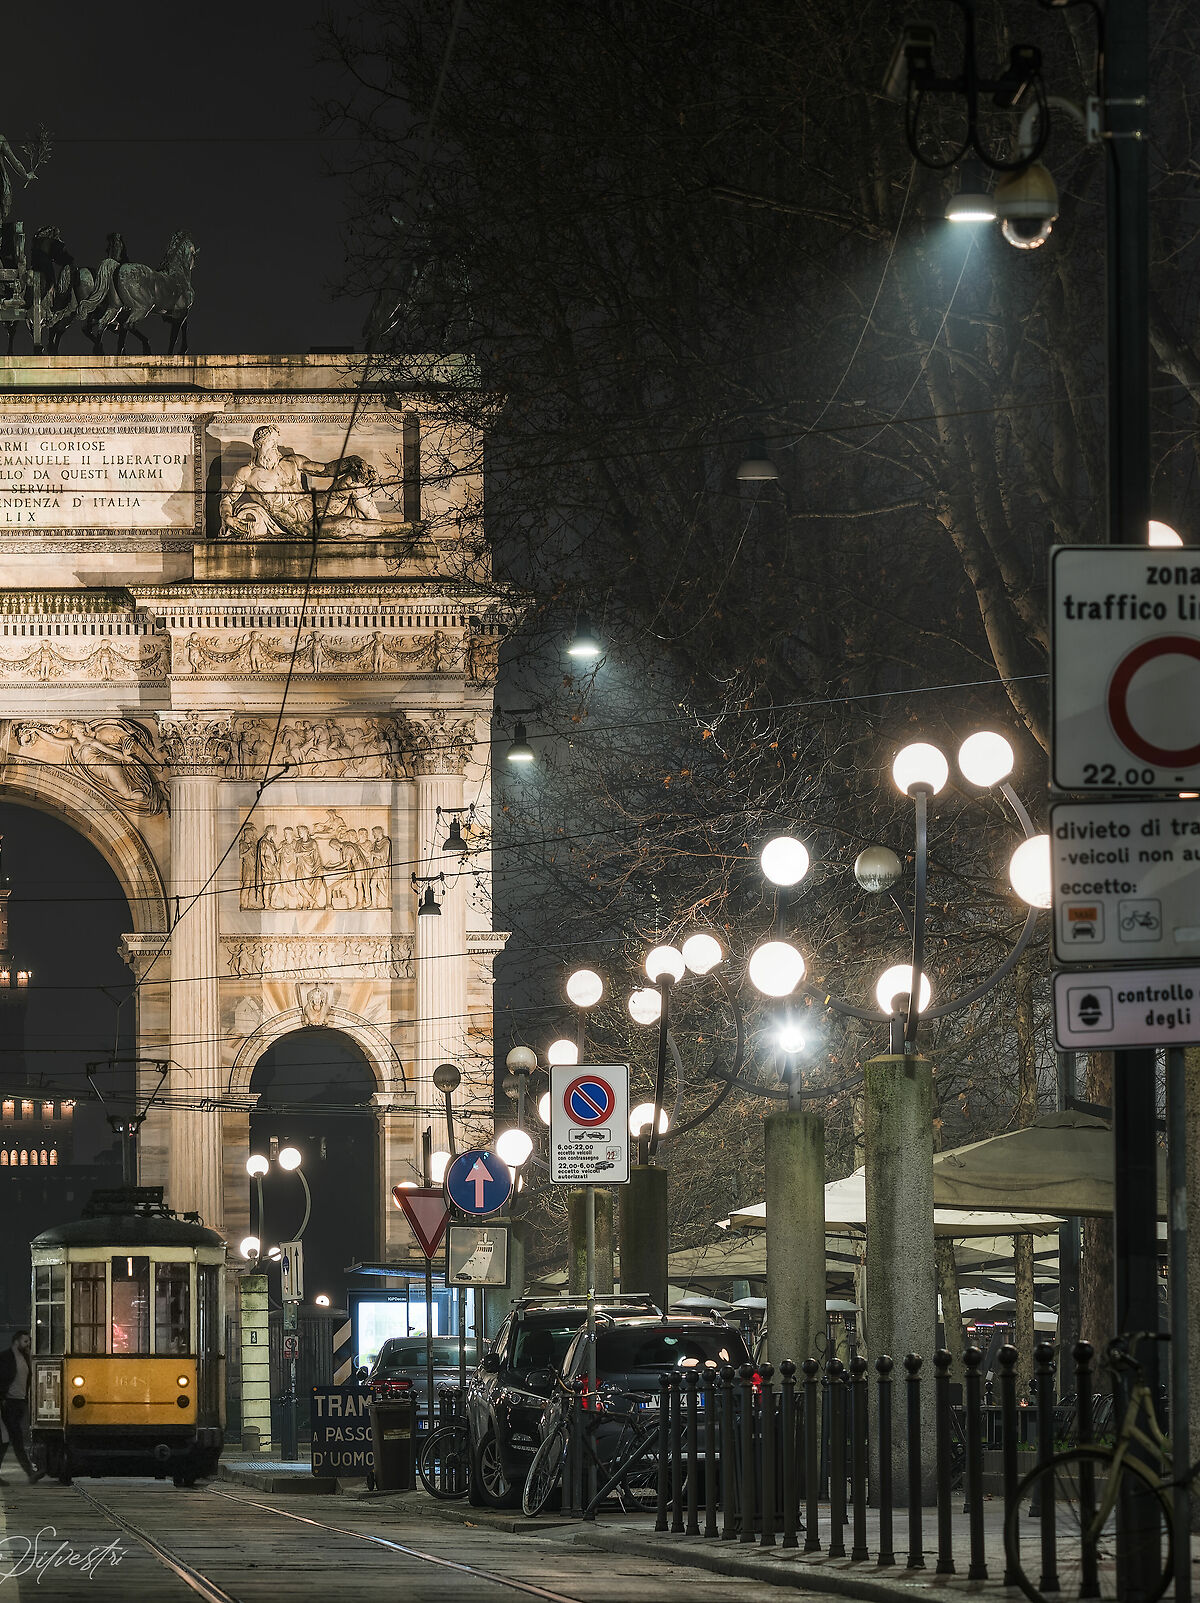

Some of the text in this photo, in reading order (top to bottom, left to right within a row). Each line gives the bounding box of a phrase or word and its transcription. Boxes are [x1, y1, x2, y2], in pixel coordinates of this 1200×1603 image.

[40, 442, 105, 451] GLORIOSE
[82, 455, 90, 465] II
[103, 455, 187, 465] LIBERATORI
[34, 470, 49, 480] DA
[61, 469, 107, 480] QUESTI
[118, 469, 163, 479] MARMI
[12, 484, 64, 494] SERVILI
[94, 497, 140, 507] ITALIA
[1146, 566, 1200, 585] zona
[1064, 594, 1200, 620] traffico li
[1083, 763, 1156, 786] 22.00
[1056, 818, 1200, 840] divieto di tra
[1139, 849, 1174, 863] non
[1060, 879, 1137, 895] eccetto:
[1118, 985, 1193, 1004] controllo
[1146, 1008, 1191, 1029] degli
[127, 1257, 132, 1276] 1
[314, 1395, 372, 1417] TRAM
[313, 1431, 318, 1441] A
[313, 1451, 374, 1467] D'UOMO
